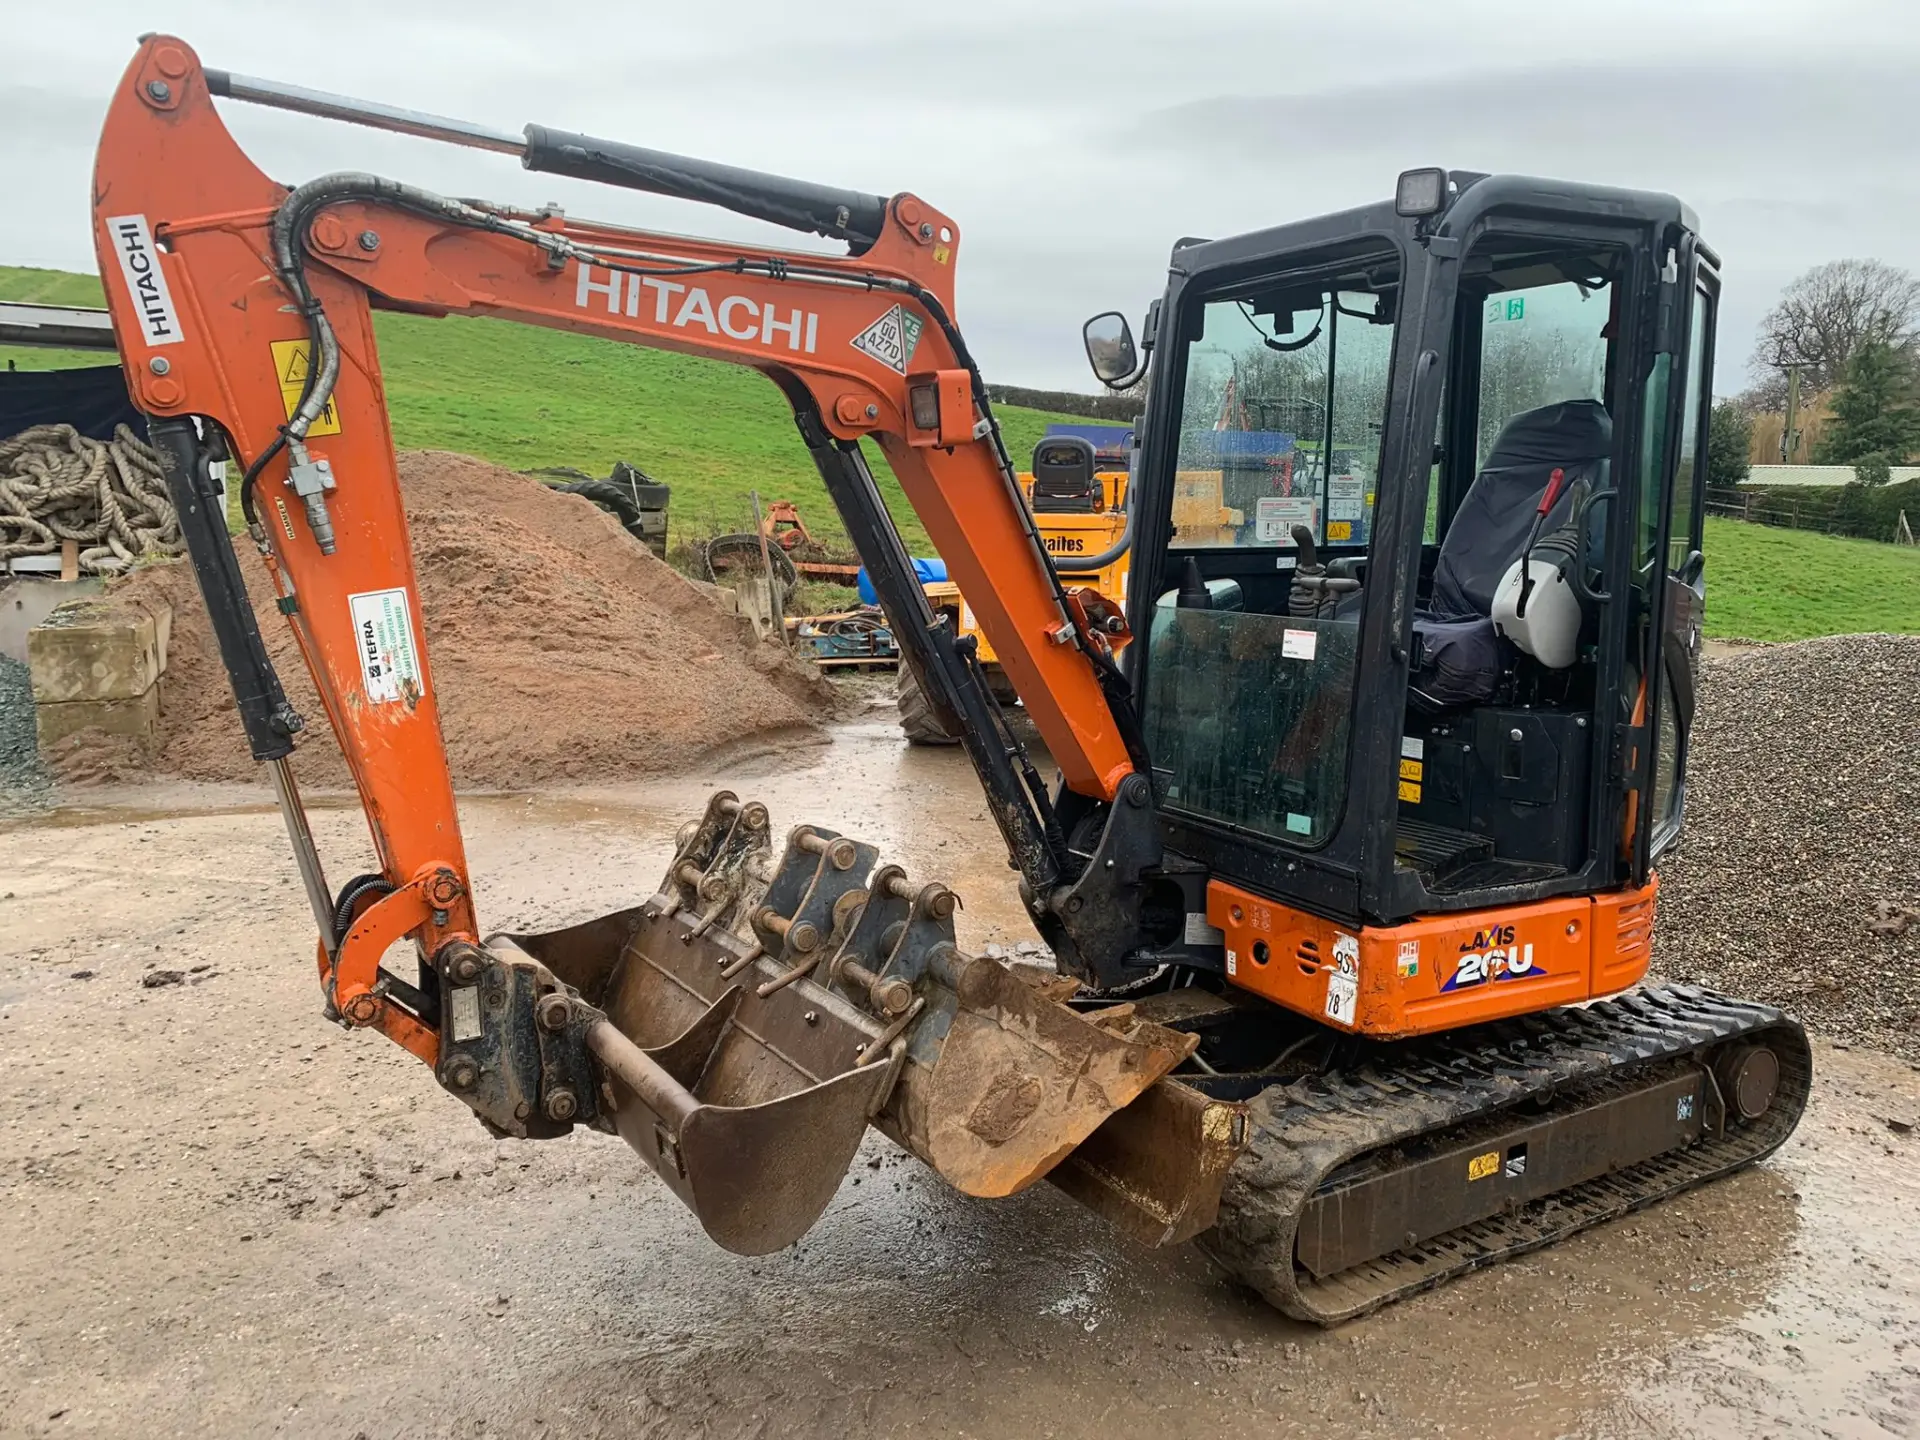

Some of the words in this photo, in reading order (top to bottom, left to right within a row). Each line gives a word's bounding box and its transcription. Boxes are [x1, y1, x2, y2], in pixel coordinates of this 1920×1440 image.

[118, 223, 171, 336] HITACHI
[576, 262, 818, 353] HITACHI
[277, 503, 295, 538] HAMMER
[1044, 535, 1083, 552] aites
[363, 619, 378, 663] TEFRA
